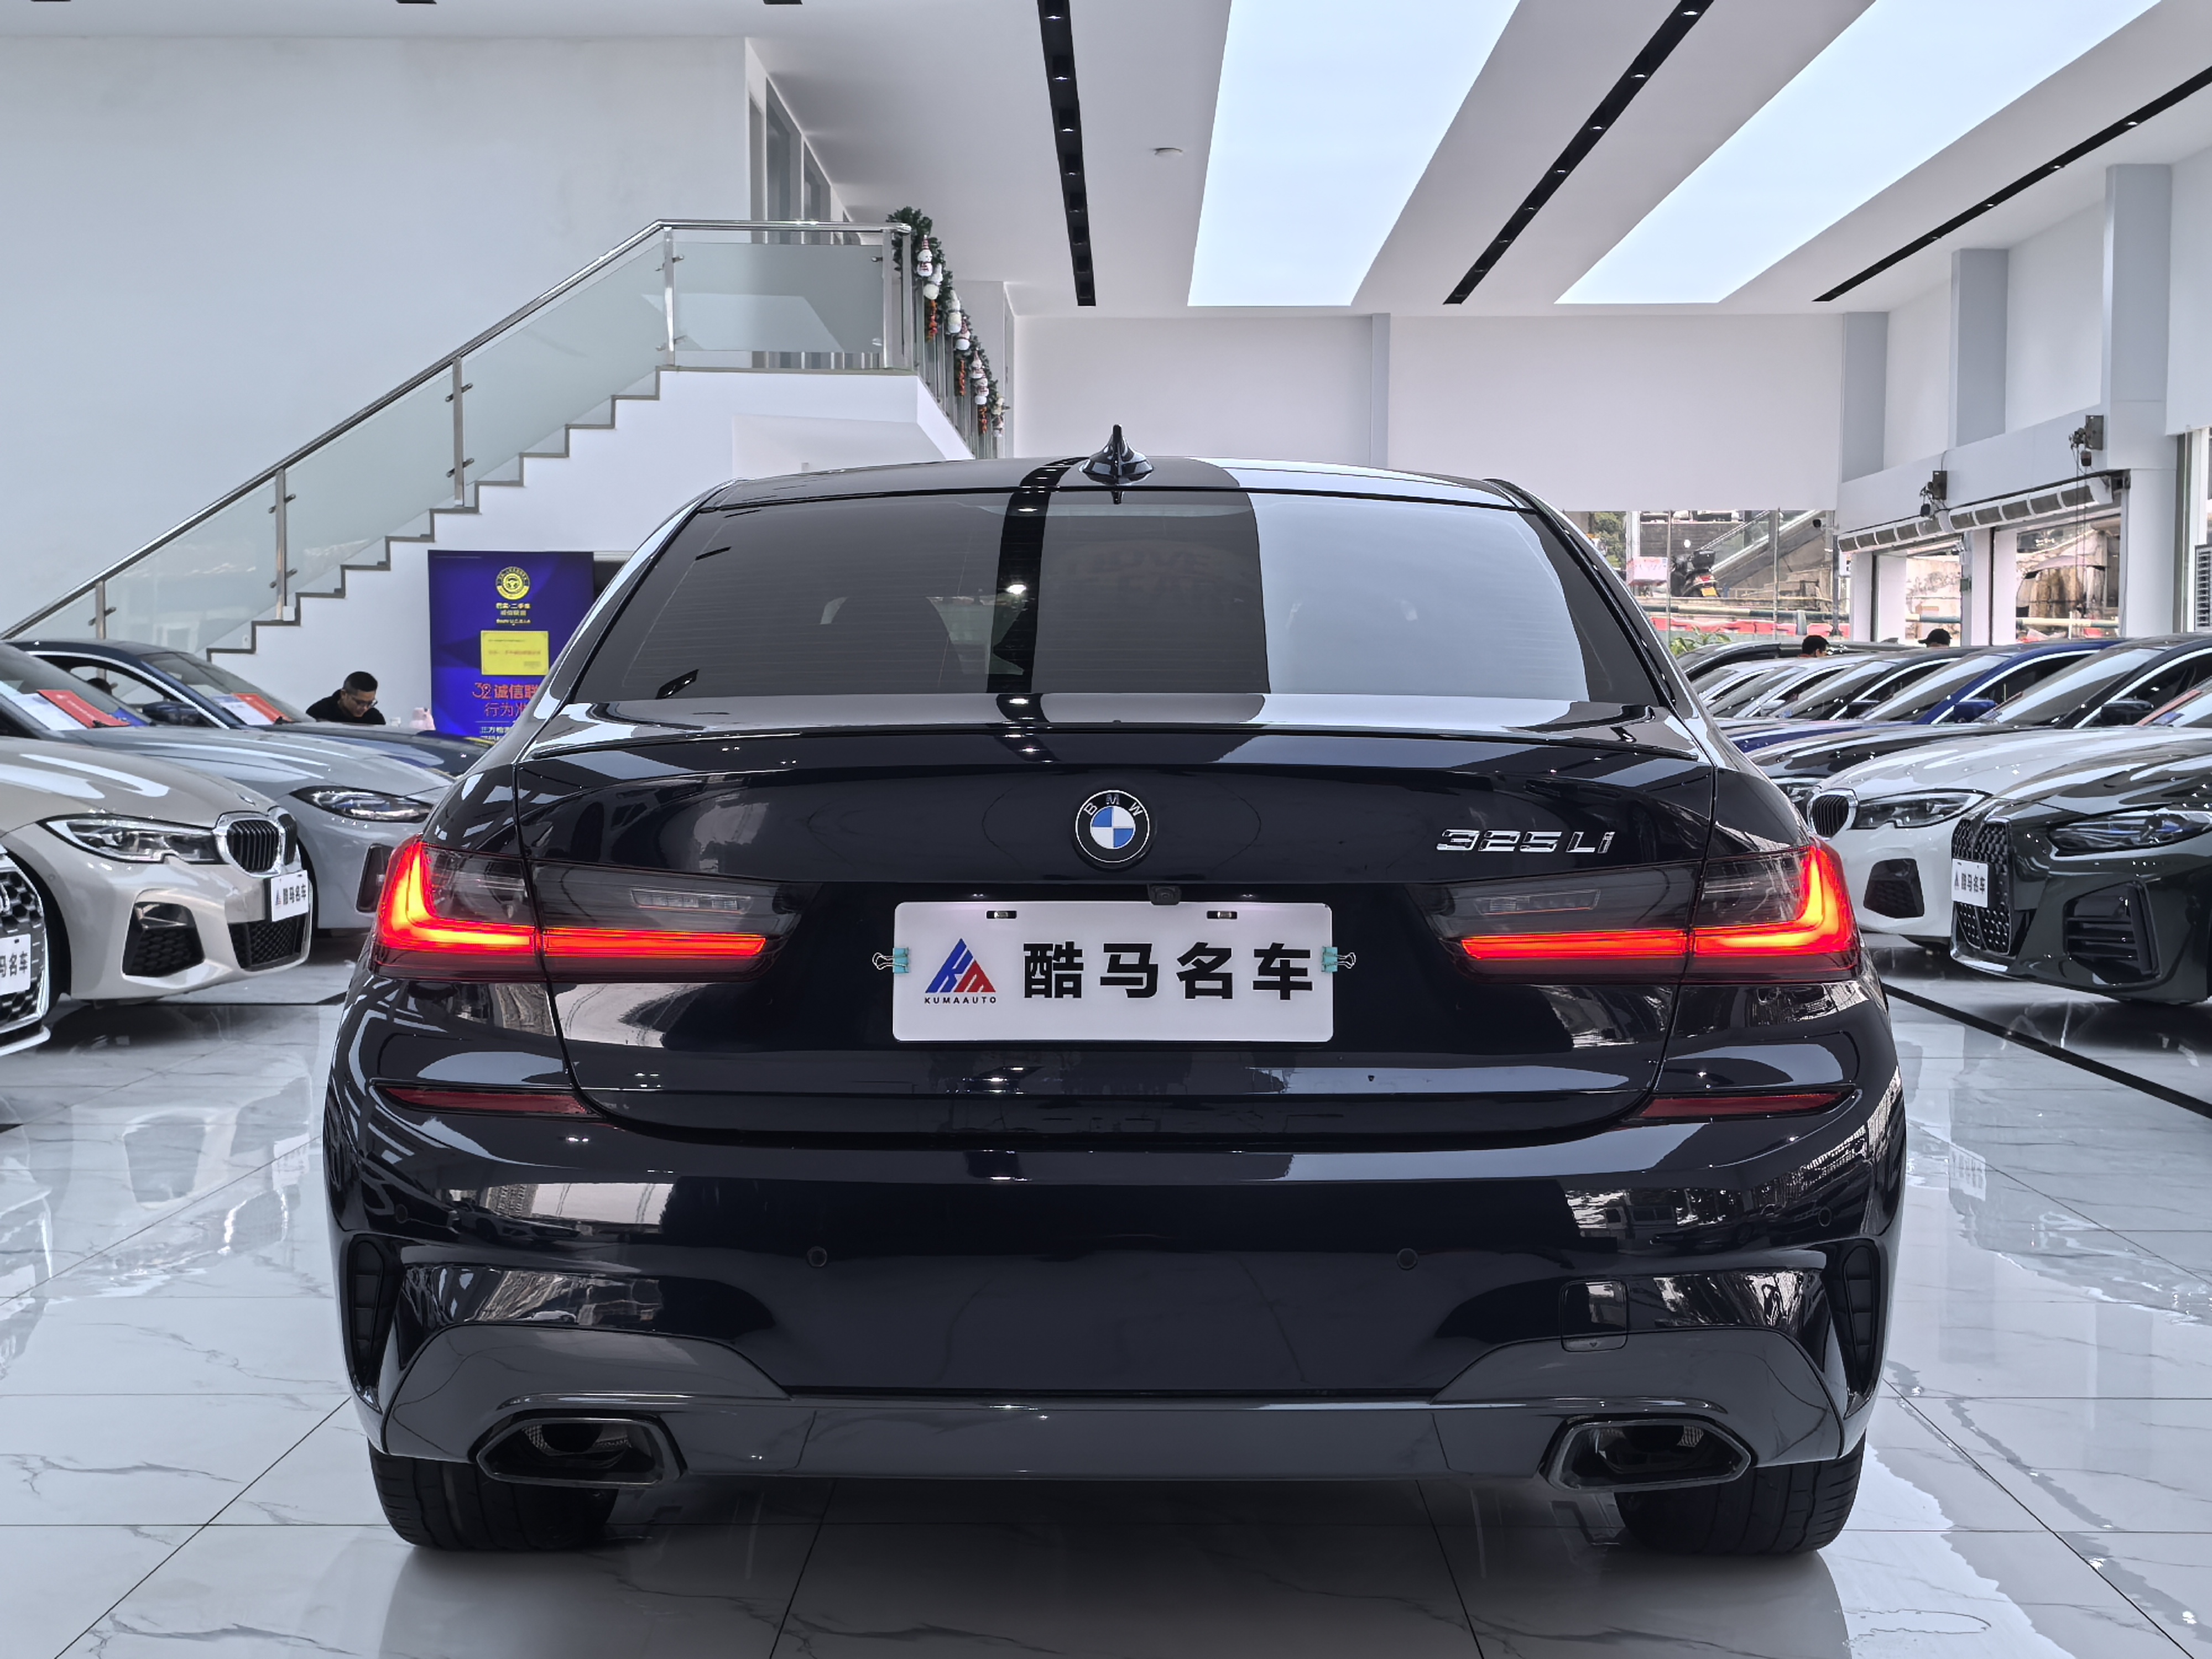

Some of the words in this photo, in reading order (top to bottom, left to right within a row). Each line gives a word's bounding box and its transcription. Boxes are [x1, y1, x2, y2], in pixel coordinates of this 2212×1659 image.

[1083, 794, 1144, 816] BMW
[1023, 941, 1313, 1000] 酷马名车
